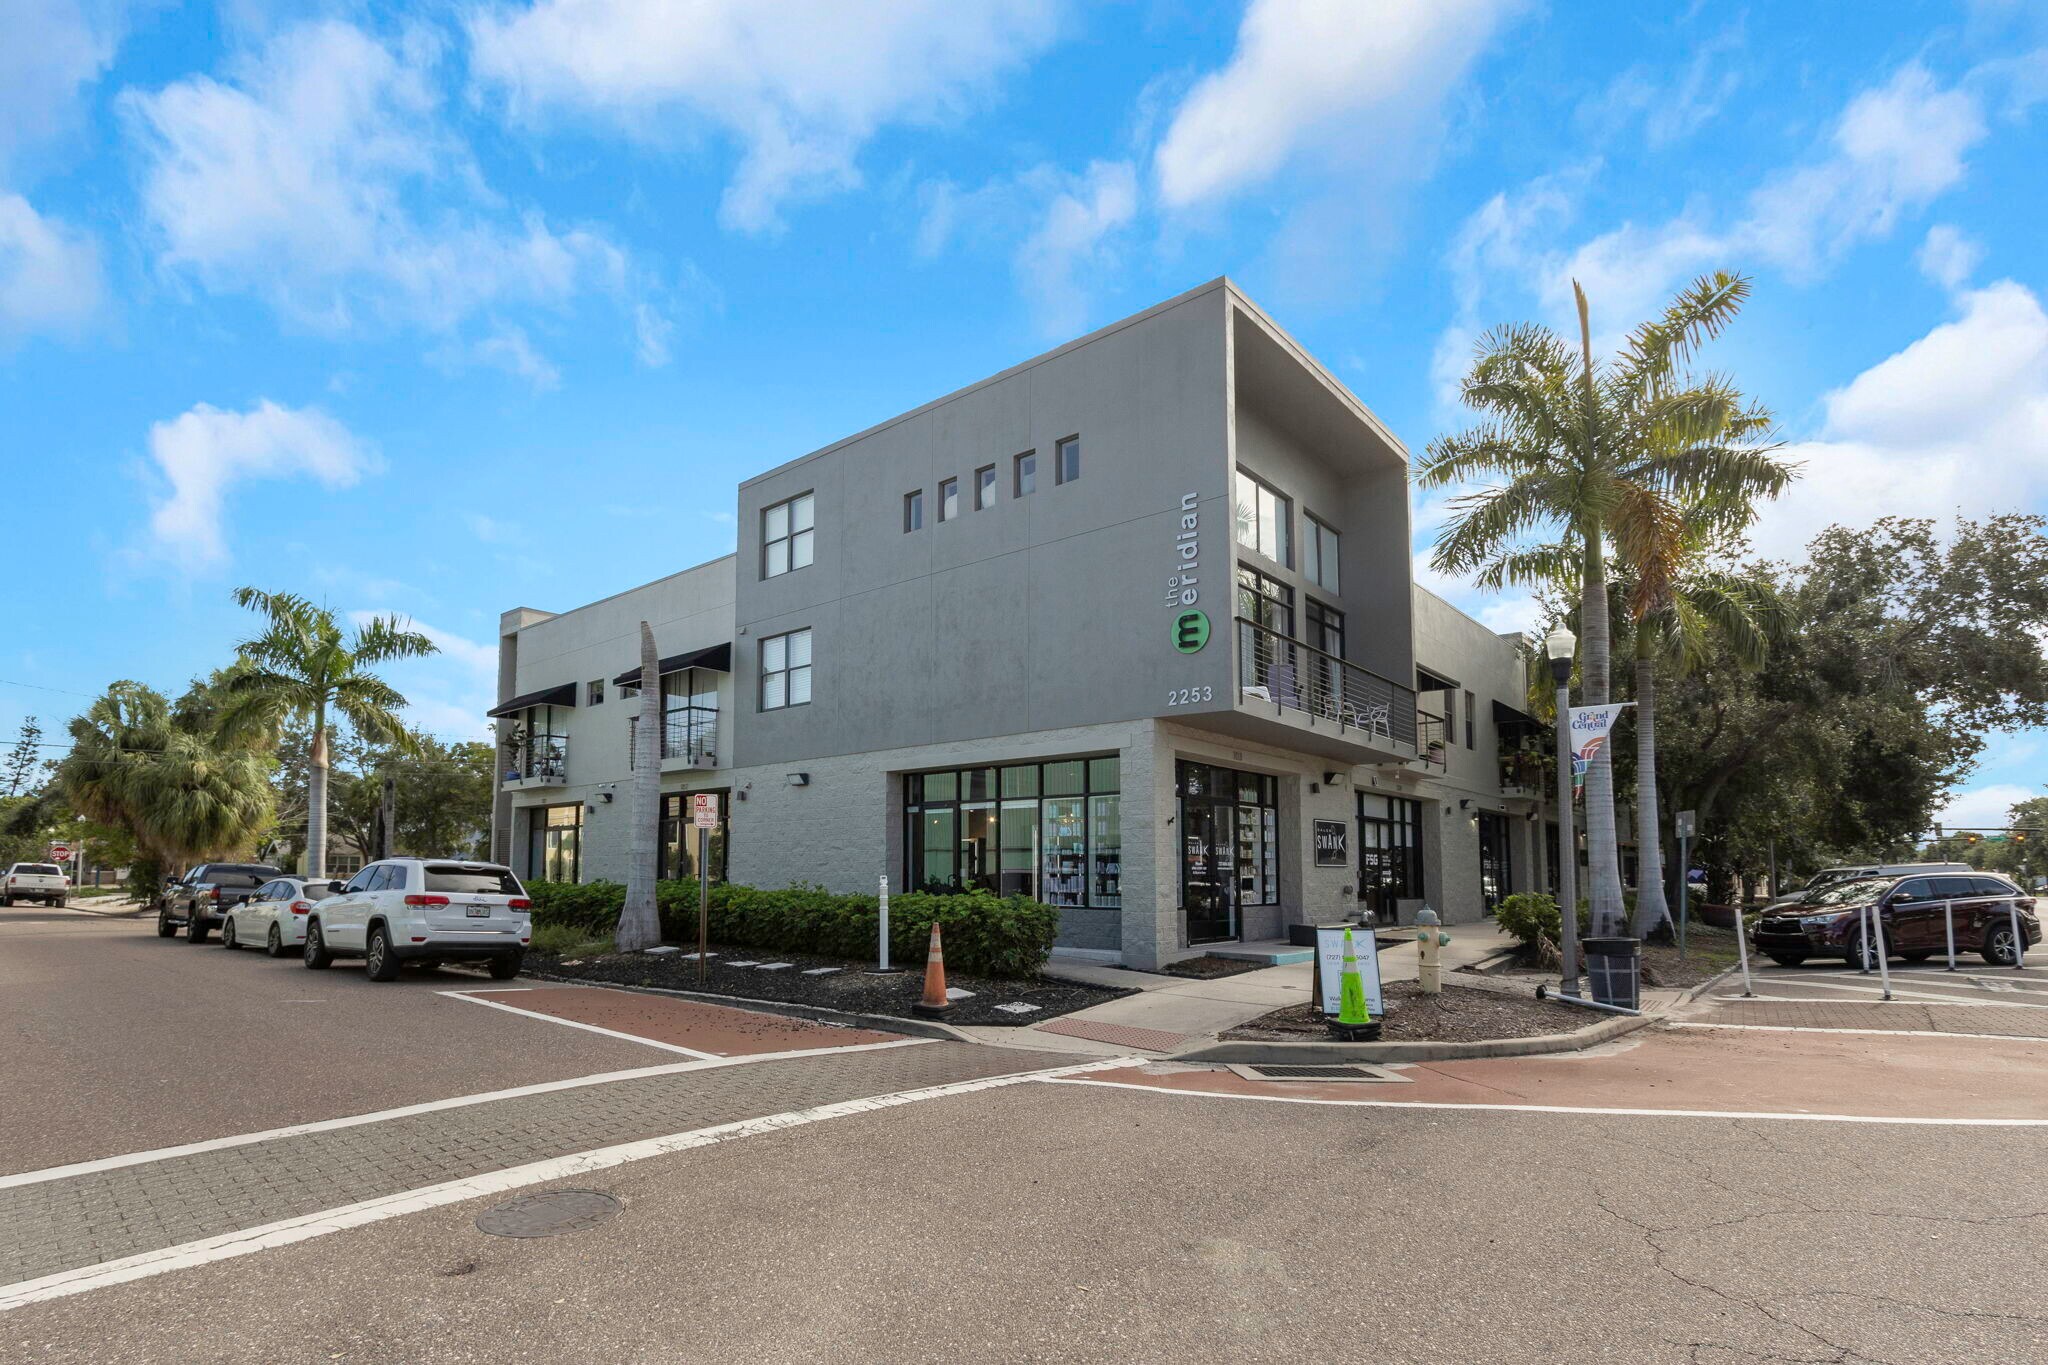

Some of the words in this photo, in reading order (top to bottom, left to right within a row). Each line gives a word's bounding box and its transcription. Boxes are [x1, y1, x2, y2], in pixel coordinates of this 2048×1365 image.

[1165, 577, 1178, 607] the
[1168, 686, 1212, 706] 2253
[1579, 711, 1608, 722] Grand
[1572, 719, 1607, 731] Central
[696, 796, 707, 805] NO
[1317, 833, 1346, 853] SWANK
[1365, 854, 1379, 866] FSG
